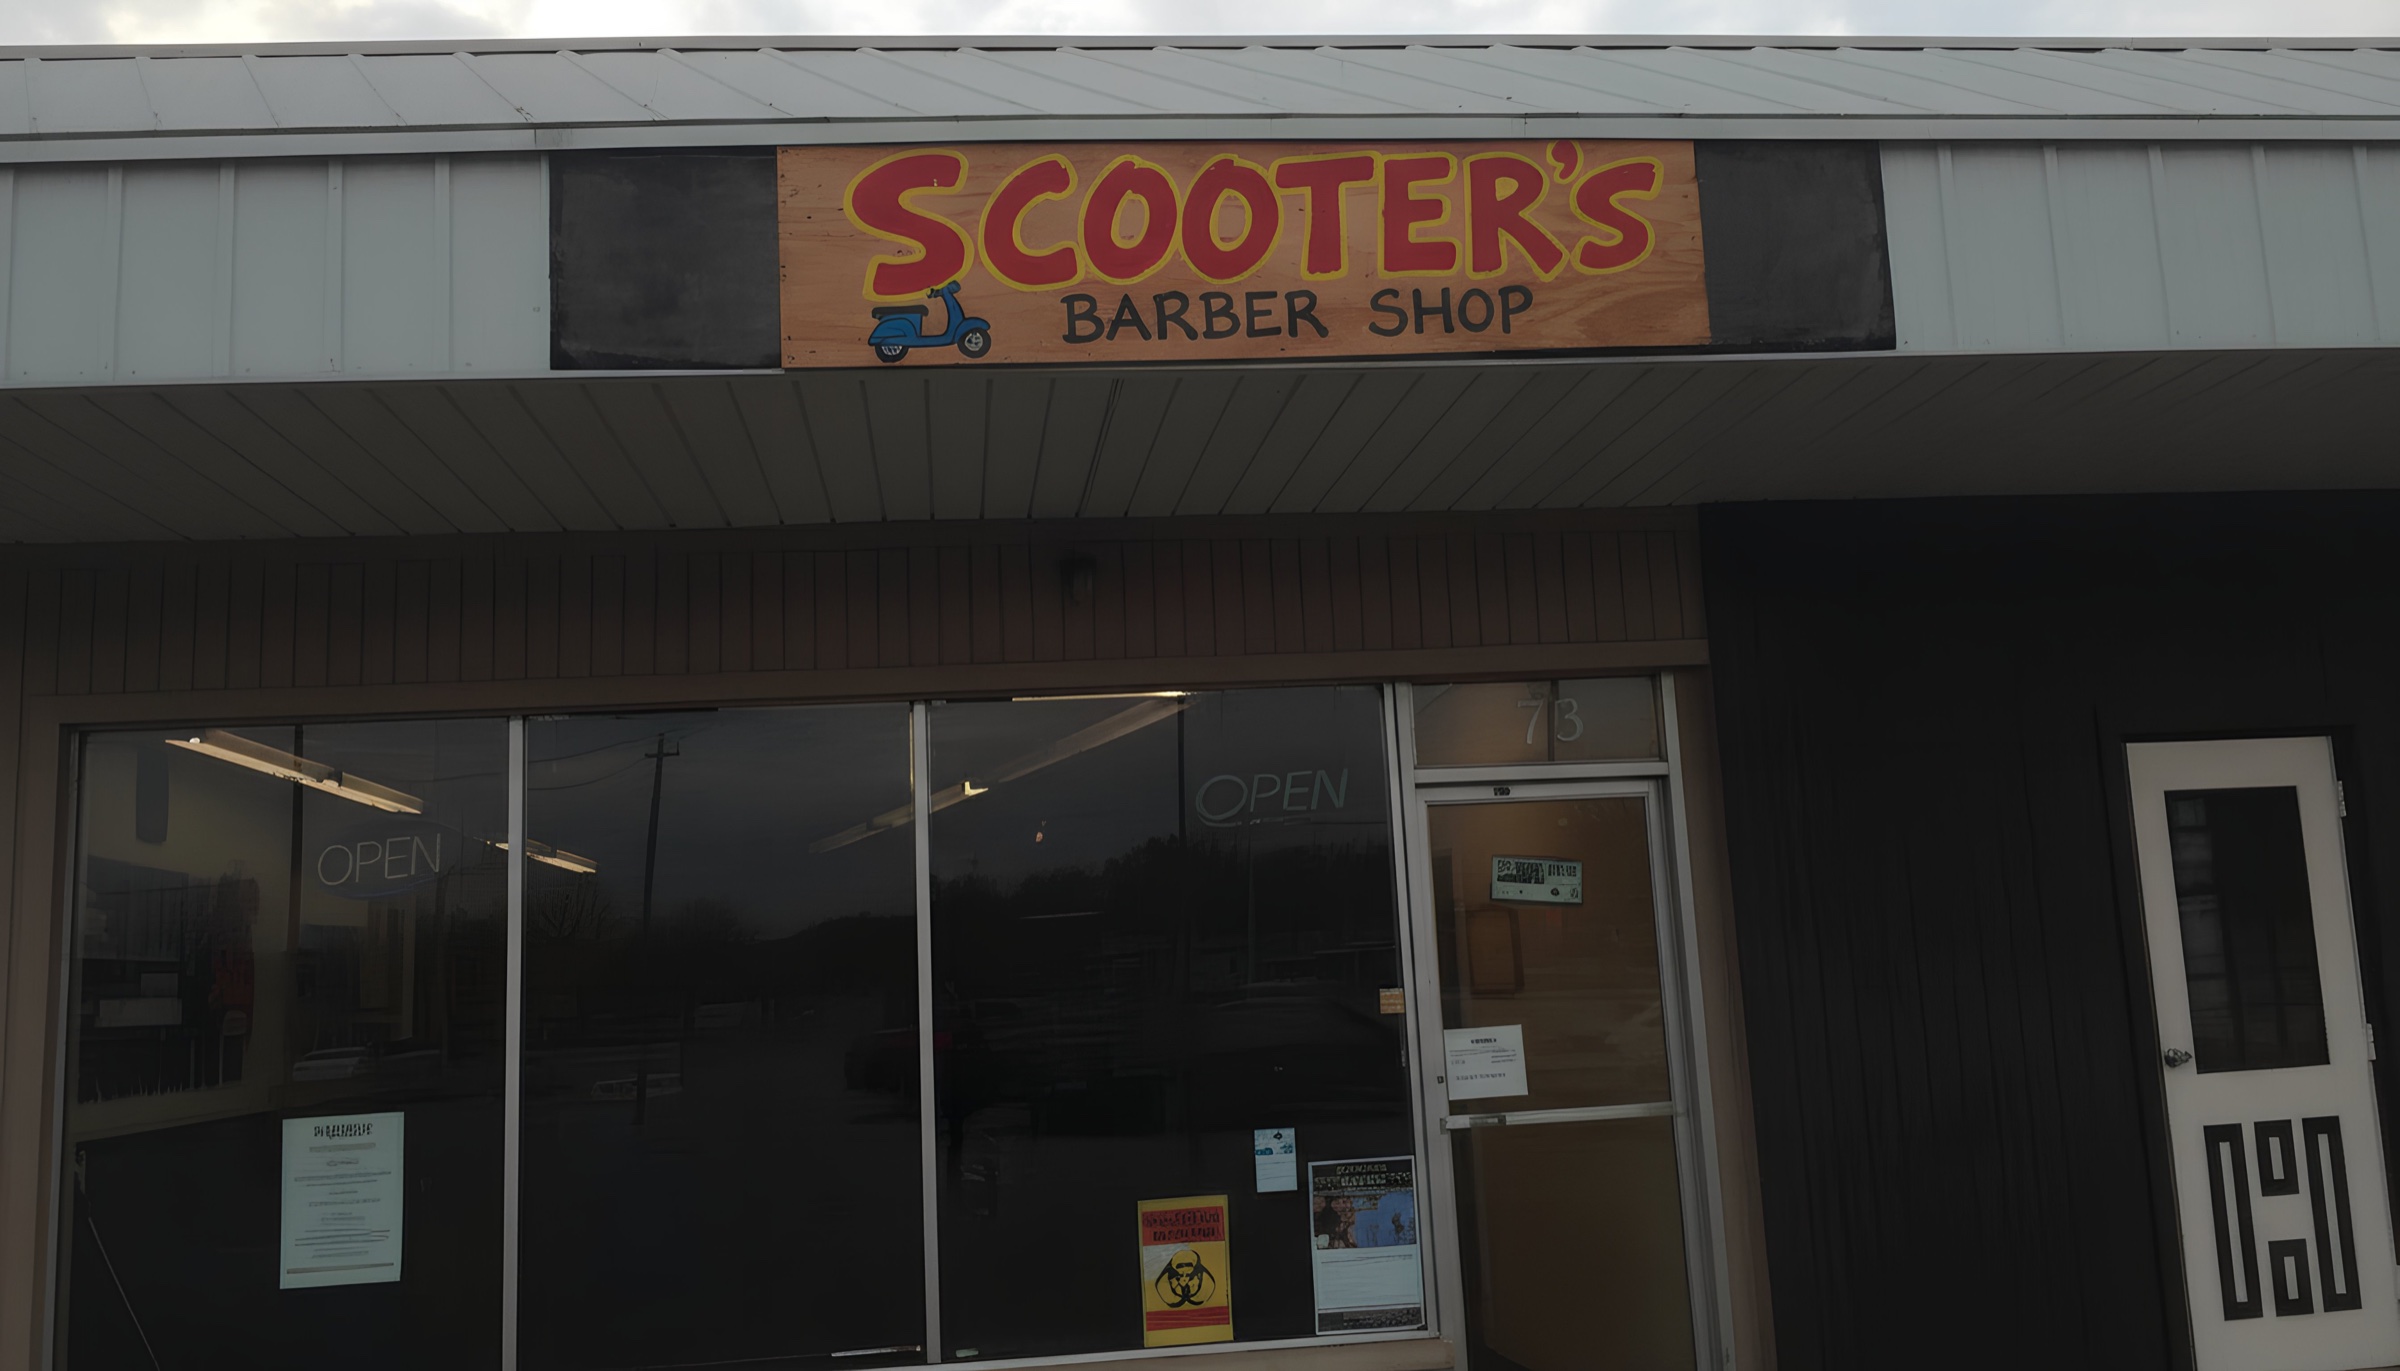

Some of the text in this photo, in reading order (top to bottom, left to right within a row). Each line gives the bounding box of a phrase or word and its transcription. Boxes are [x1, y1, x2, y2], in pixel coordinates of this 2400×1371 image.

[844, 138, 1664, 300] SCOOTER'S
[1061, 284, 1534, 344] BARBER SHOP
[1516, 698, 1584, 745] 73
[1195, 767, 1349, 821] OPEN
[317, 832, 442, 886] OPEN
